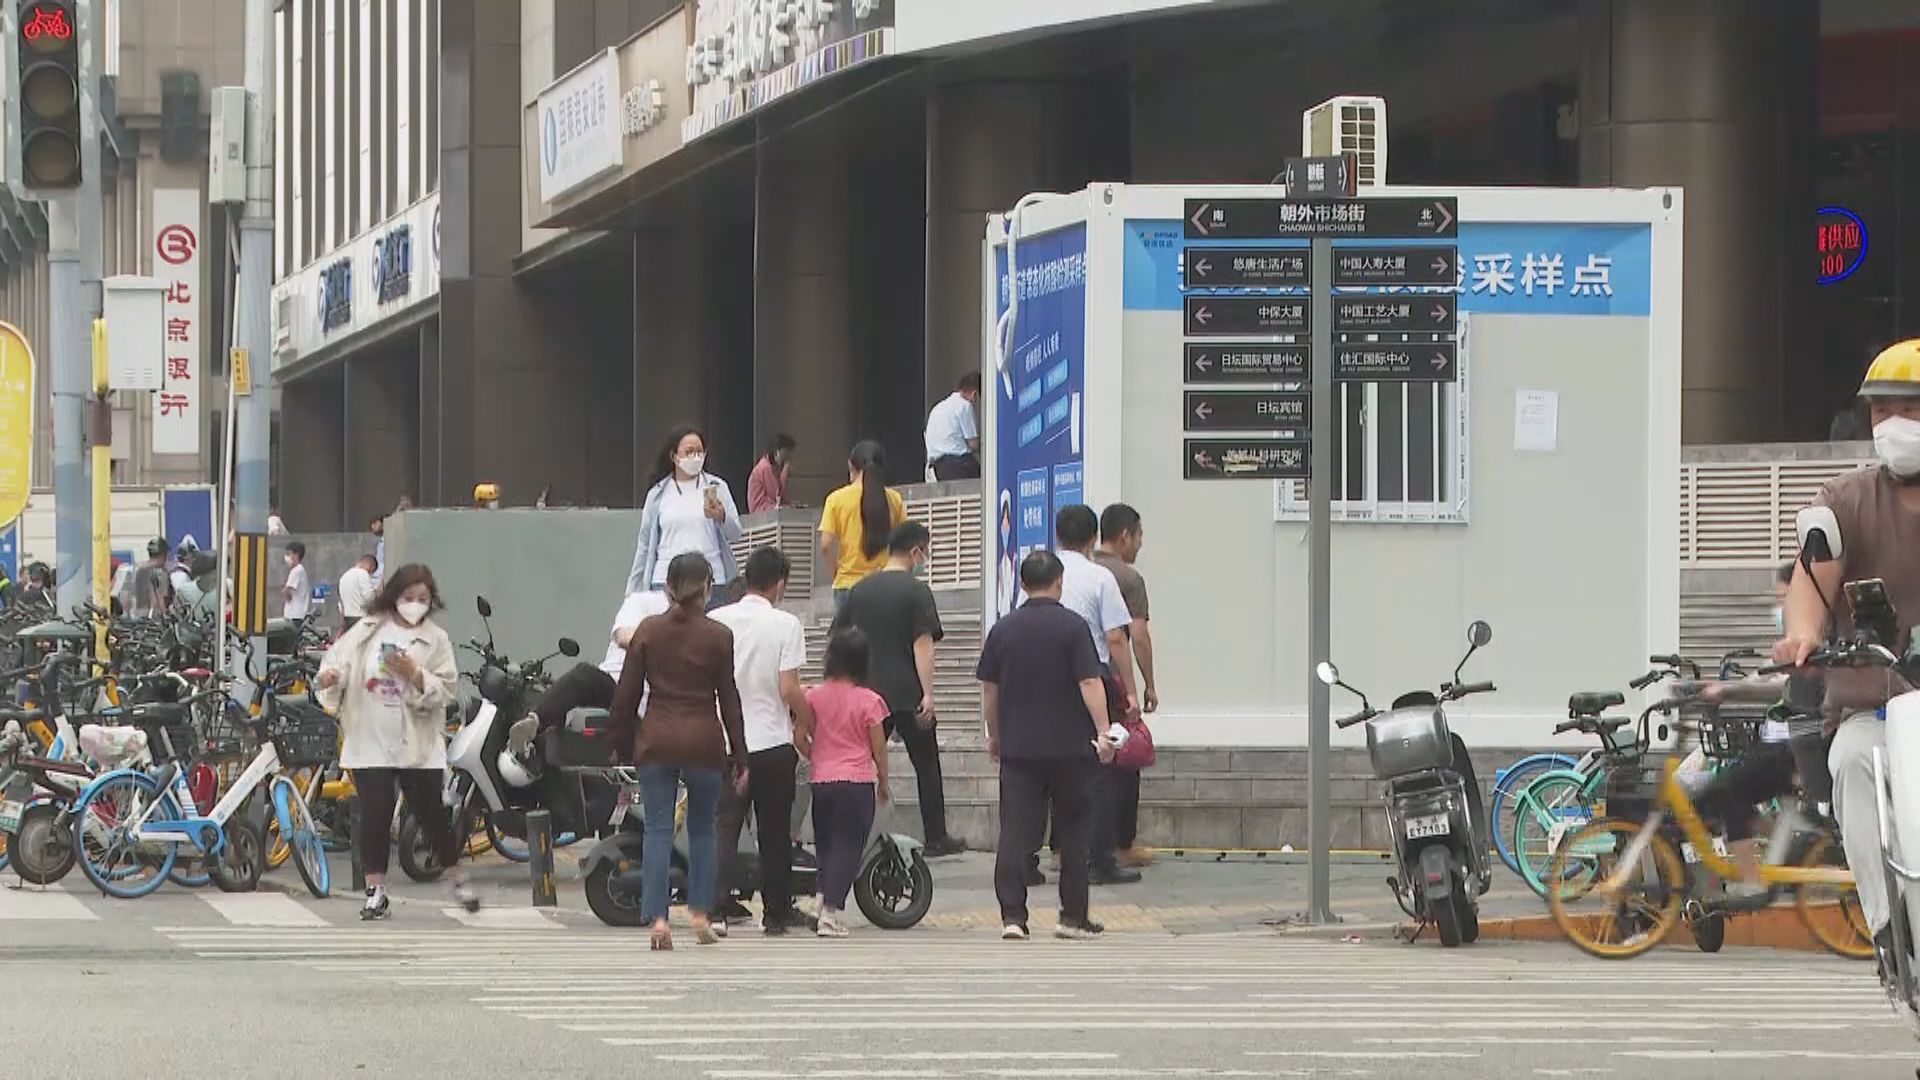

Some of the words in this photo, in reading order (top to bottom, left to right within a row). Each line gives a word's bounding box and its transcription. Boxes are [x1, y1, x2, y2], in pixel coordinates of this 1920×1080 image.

[1280, 203, 1365, 222] 朝外市场街
[1420, 208, 1432, 220] 北
[1279, 223, 1315, 232] CHAOWAI
[1340, 256, 1406, 270] 中国人寿大厦
[1258, 305, 1303, 319] 中保大厦
[1340, 304, 1410, 318] 中国工艺大厦
[160, 280, 191, 418] 北京银行
[1222, 352, 1303, 366] 日坛国际贸易中心
[1340, 351, 1410, 365] 佳汇国际中心
[1257, 401, 1303, 414] 日坛宾馆
